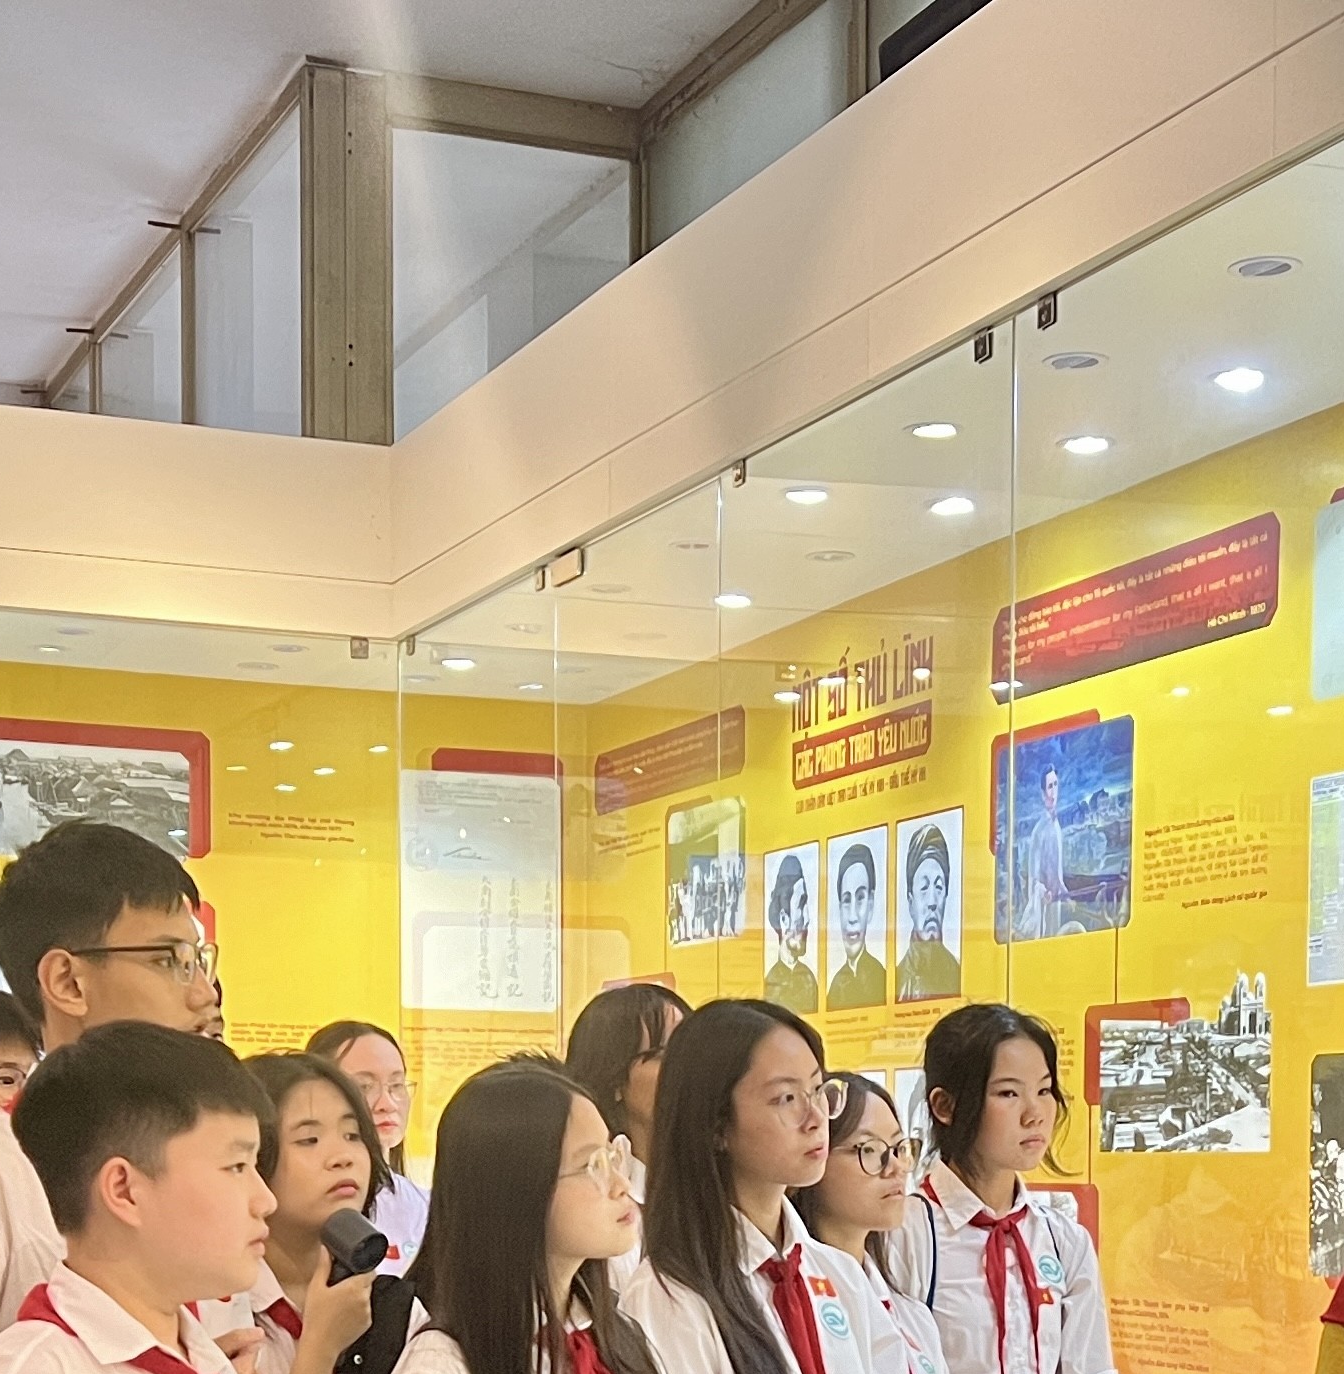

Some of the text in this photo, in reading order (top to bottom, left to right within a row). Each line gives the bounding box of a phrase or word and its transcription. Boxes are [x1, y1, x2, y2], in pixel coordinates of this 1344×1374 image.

[854, 638, 887, 712] THỦ
[795, 707, 928, 781] CÁC PHONG TRÀO YÊU NƯỚC
